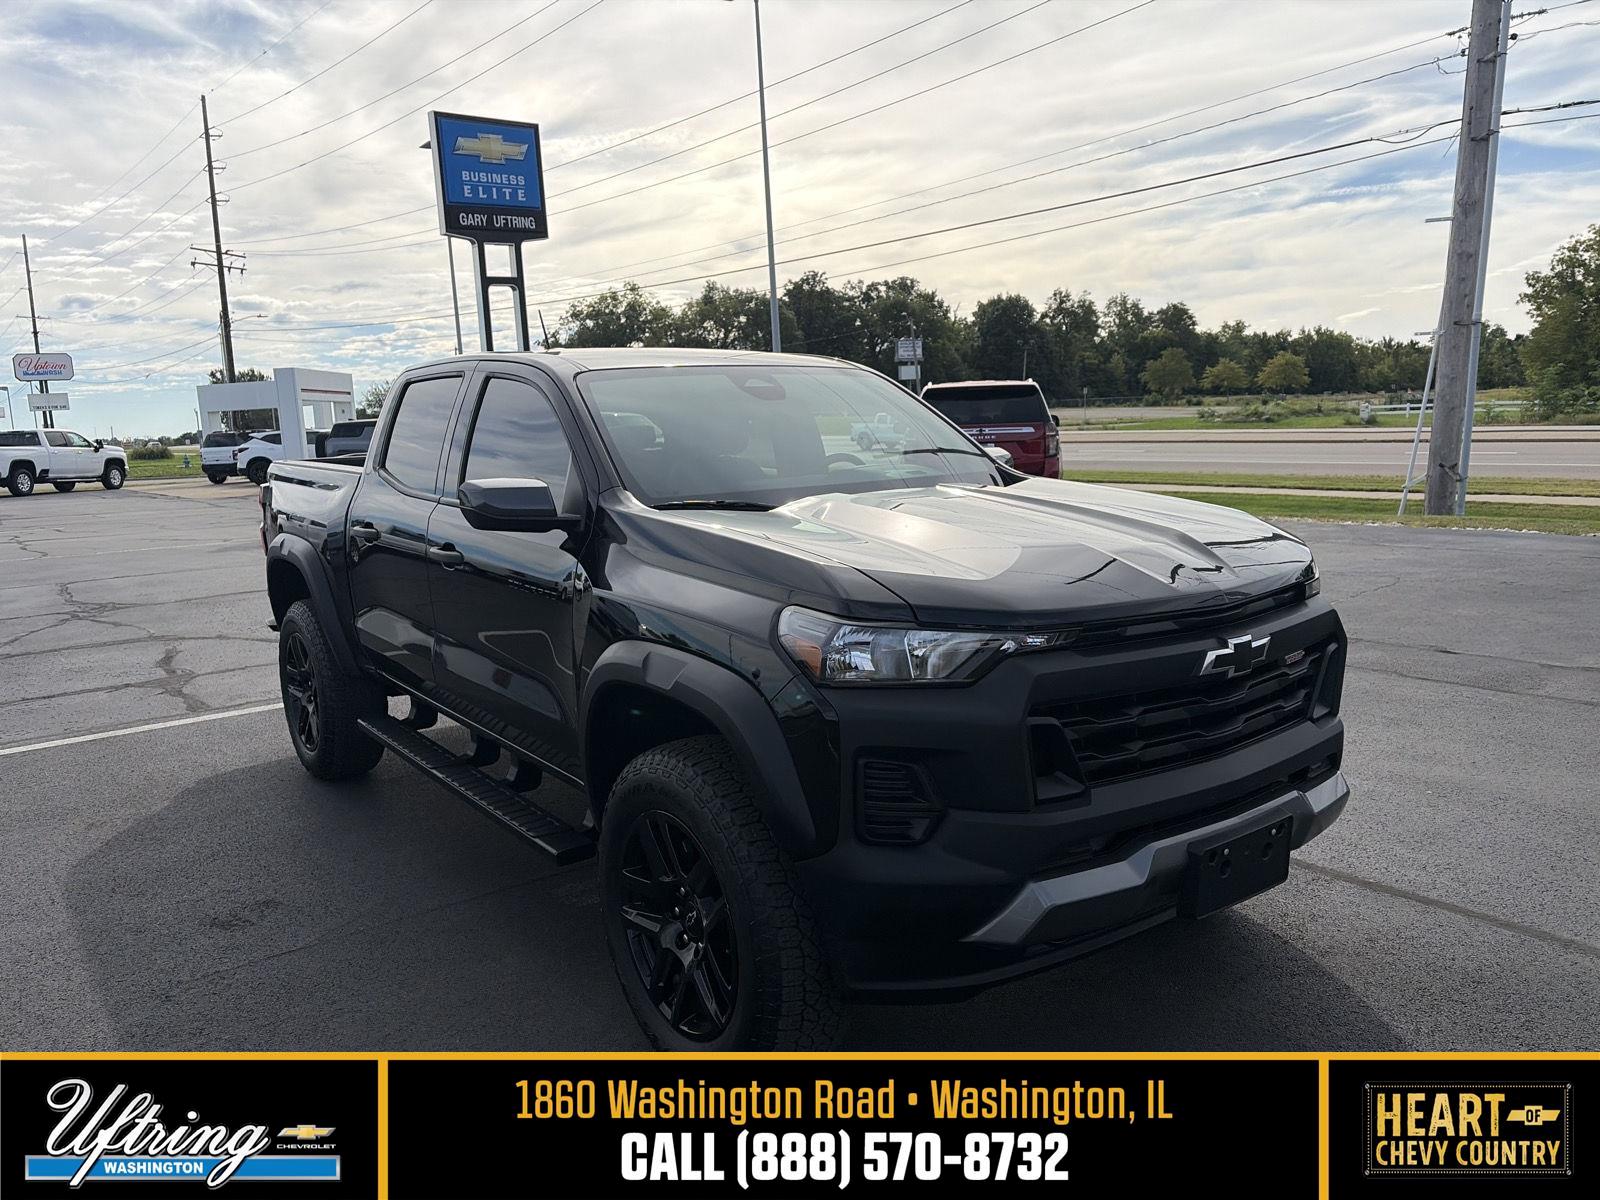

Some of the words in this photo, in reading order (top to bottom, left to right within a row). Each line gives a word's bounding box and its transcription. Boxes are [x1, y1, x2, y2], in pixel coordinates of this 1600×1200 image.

[462, 170, 525, 185] BUSINESS
[464, 185, 526, 201] ELITE
[459, 212, 487, 227] GARY
[493, 215, 536, 229] UFTRING
[18, 356, 66, 371] Uptown
